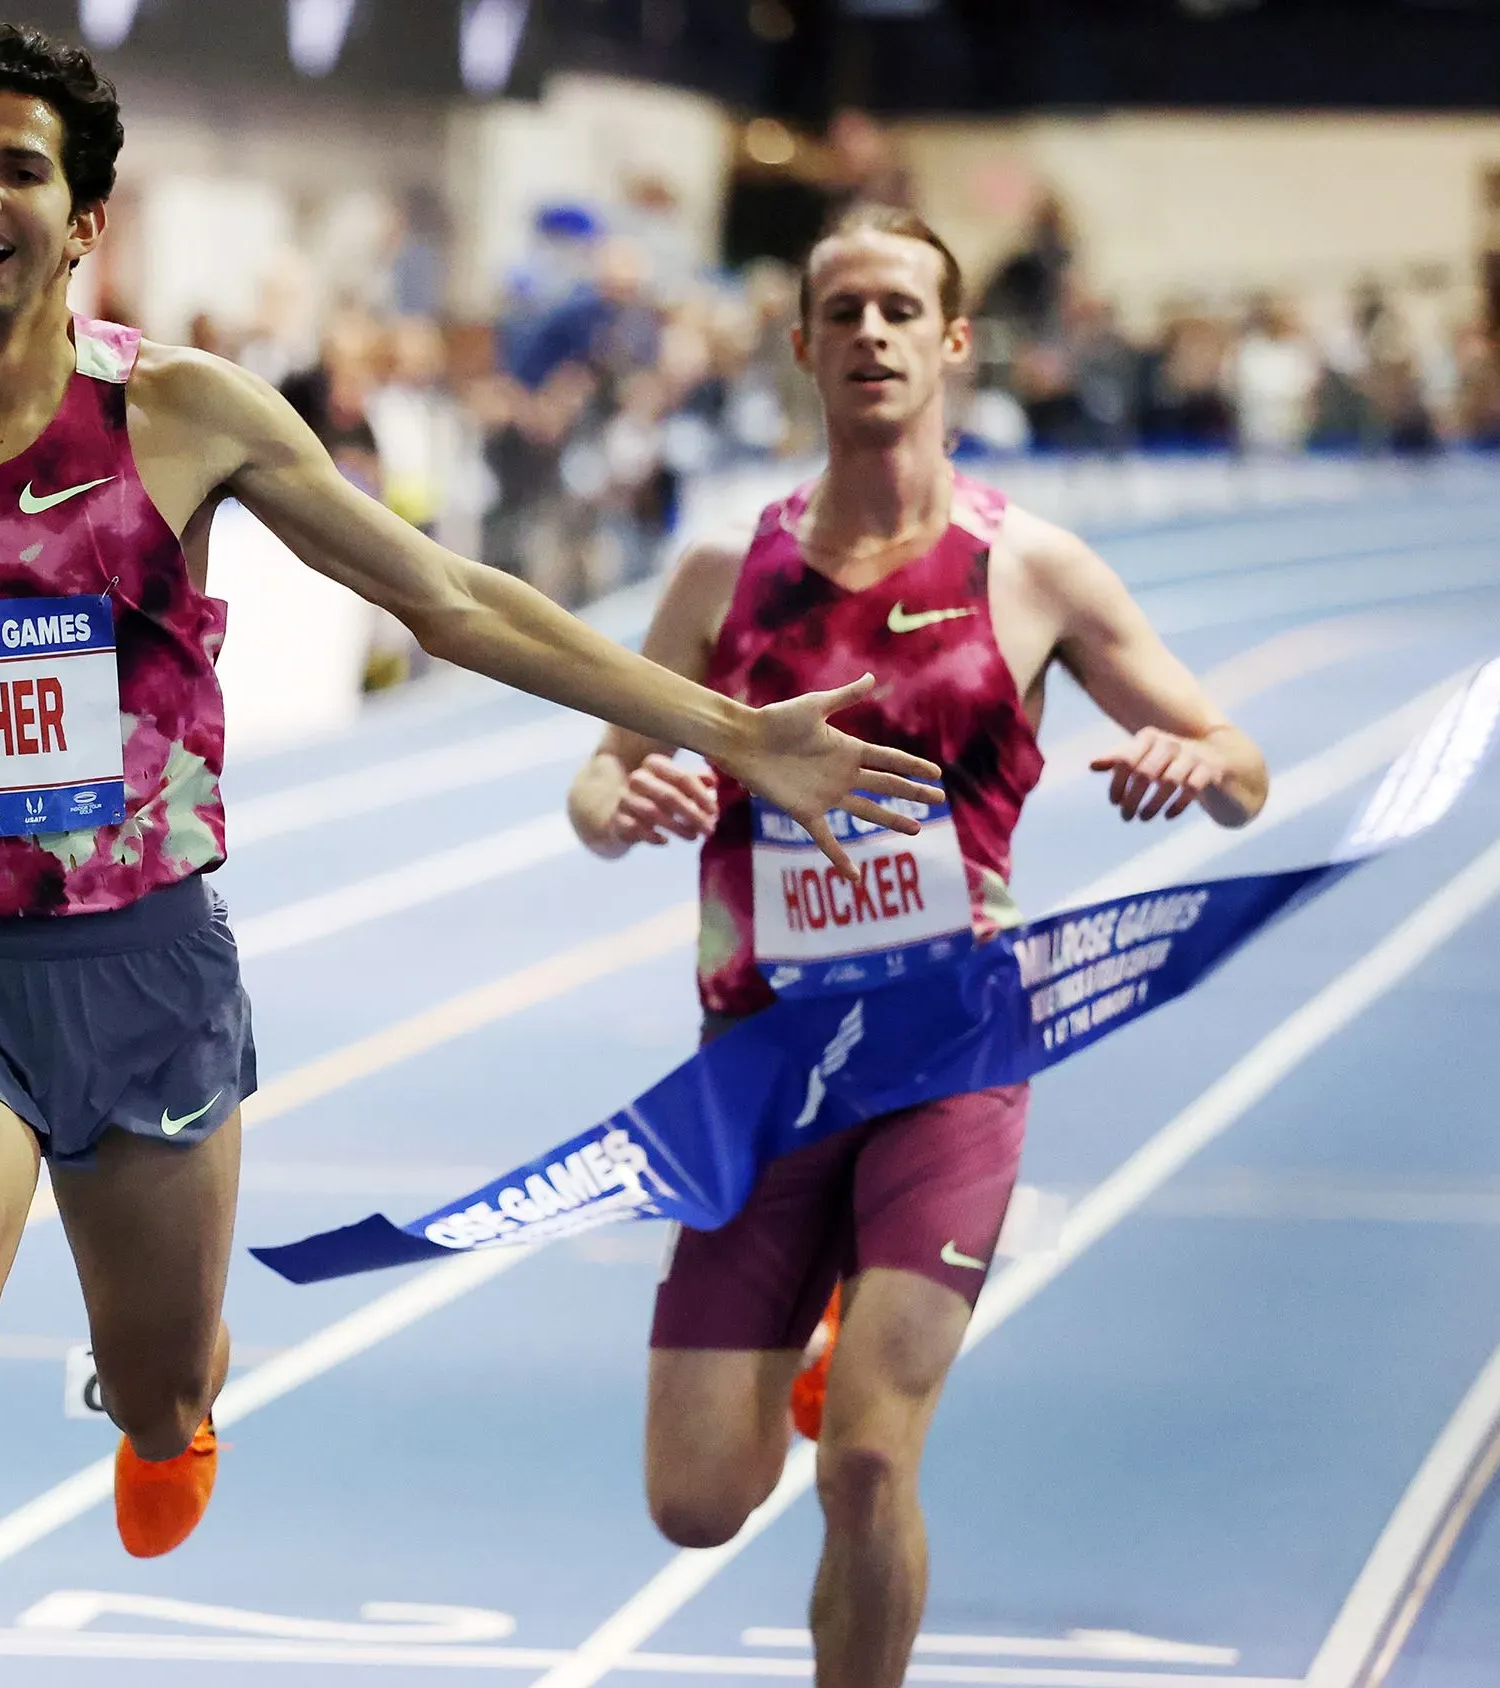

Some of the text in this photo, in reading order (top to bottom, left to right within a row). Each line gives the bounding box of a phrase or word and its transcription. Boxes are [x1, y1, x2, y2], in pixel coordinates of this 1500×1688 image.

[1, 613, 92, 649] GAMES
[24, 815, 48, 824] USATF
[781, 851, 926, 933] HOCKER
[498, 1129, 649, 1224] GAMES
